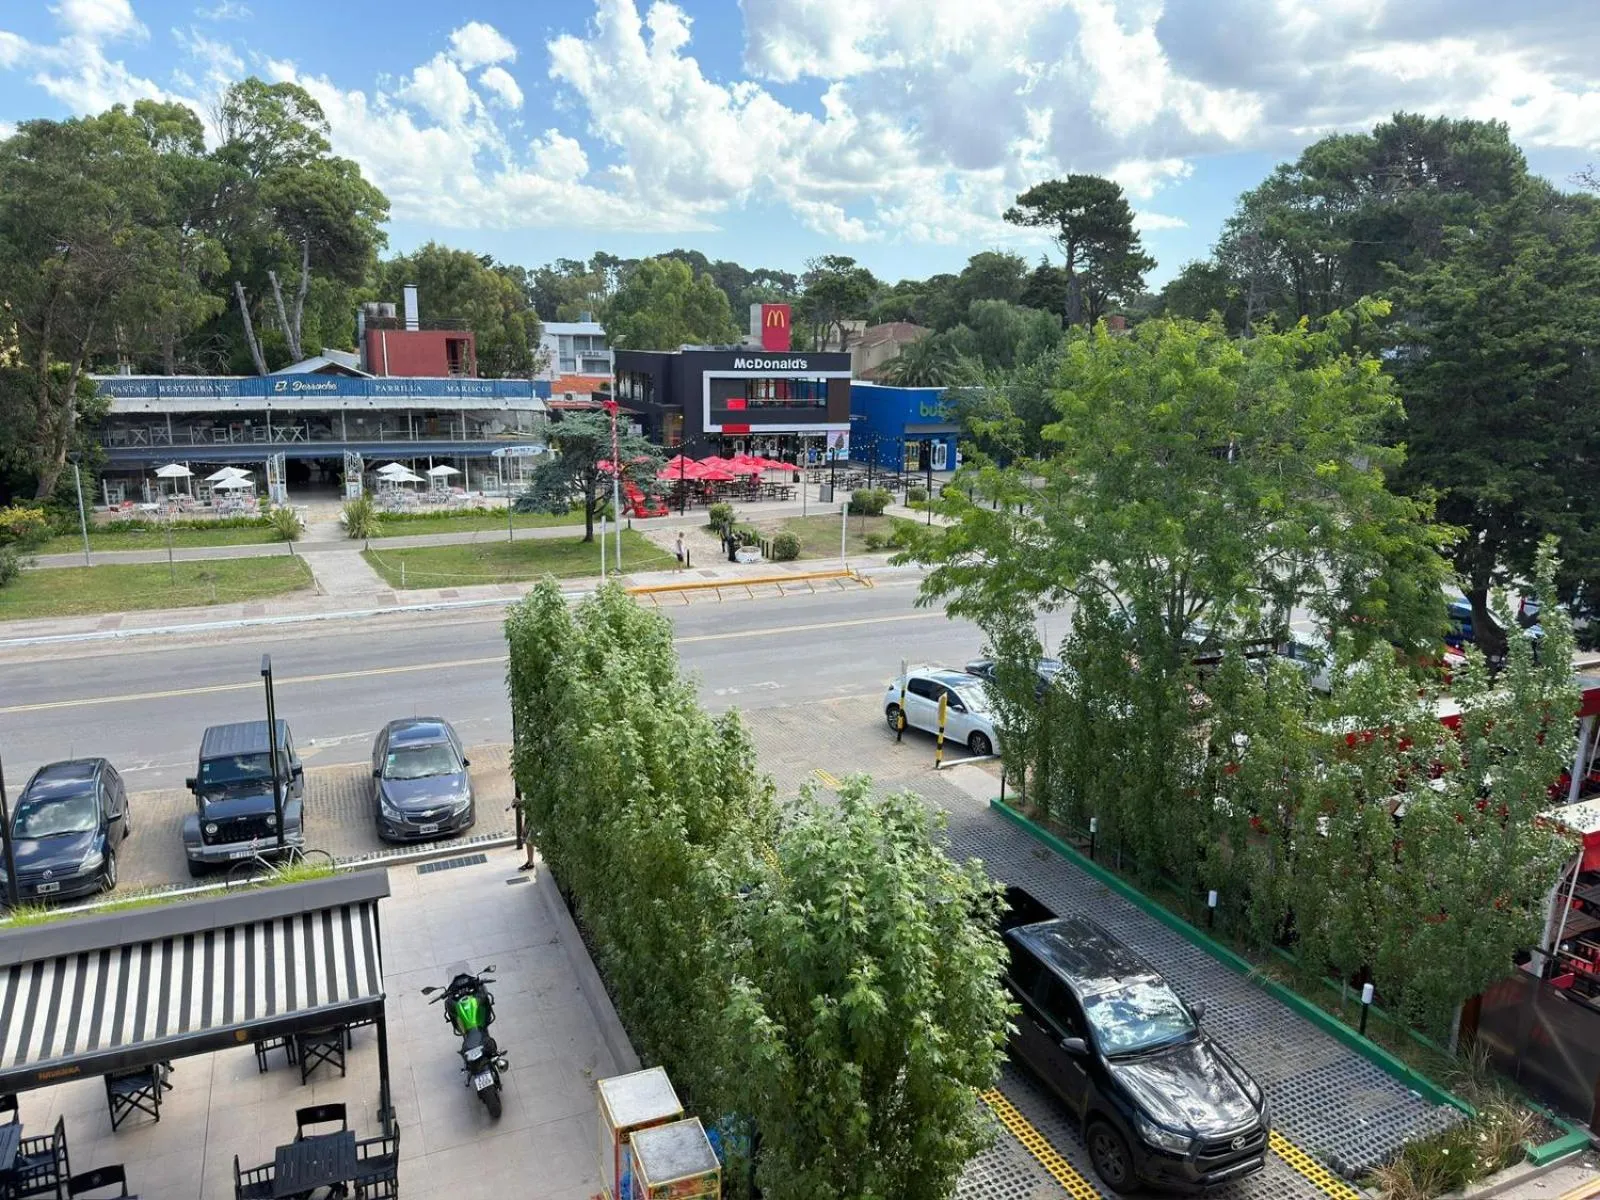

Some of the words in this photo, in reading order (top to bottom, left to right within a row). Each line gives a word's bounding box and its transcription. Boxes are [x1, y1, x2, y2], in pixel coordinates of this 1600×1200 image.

[733, 358, 808, 369] McDonald's
[159, 384, 230, 393] RESTAURANT
[375, 384, 422, 393] PARRILLA
[446, 384, 492, 393] MARISCOS
